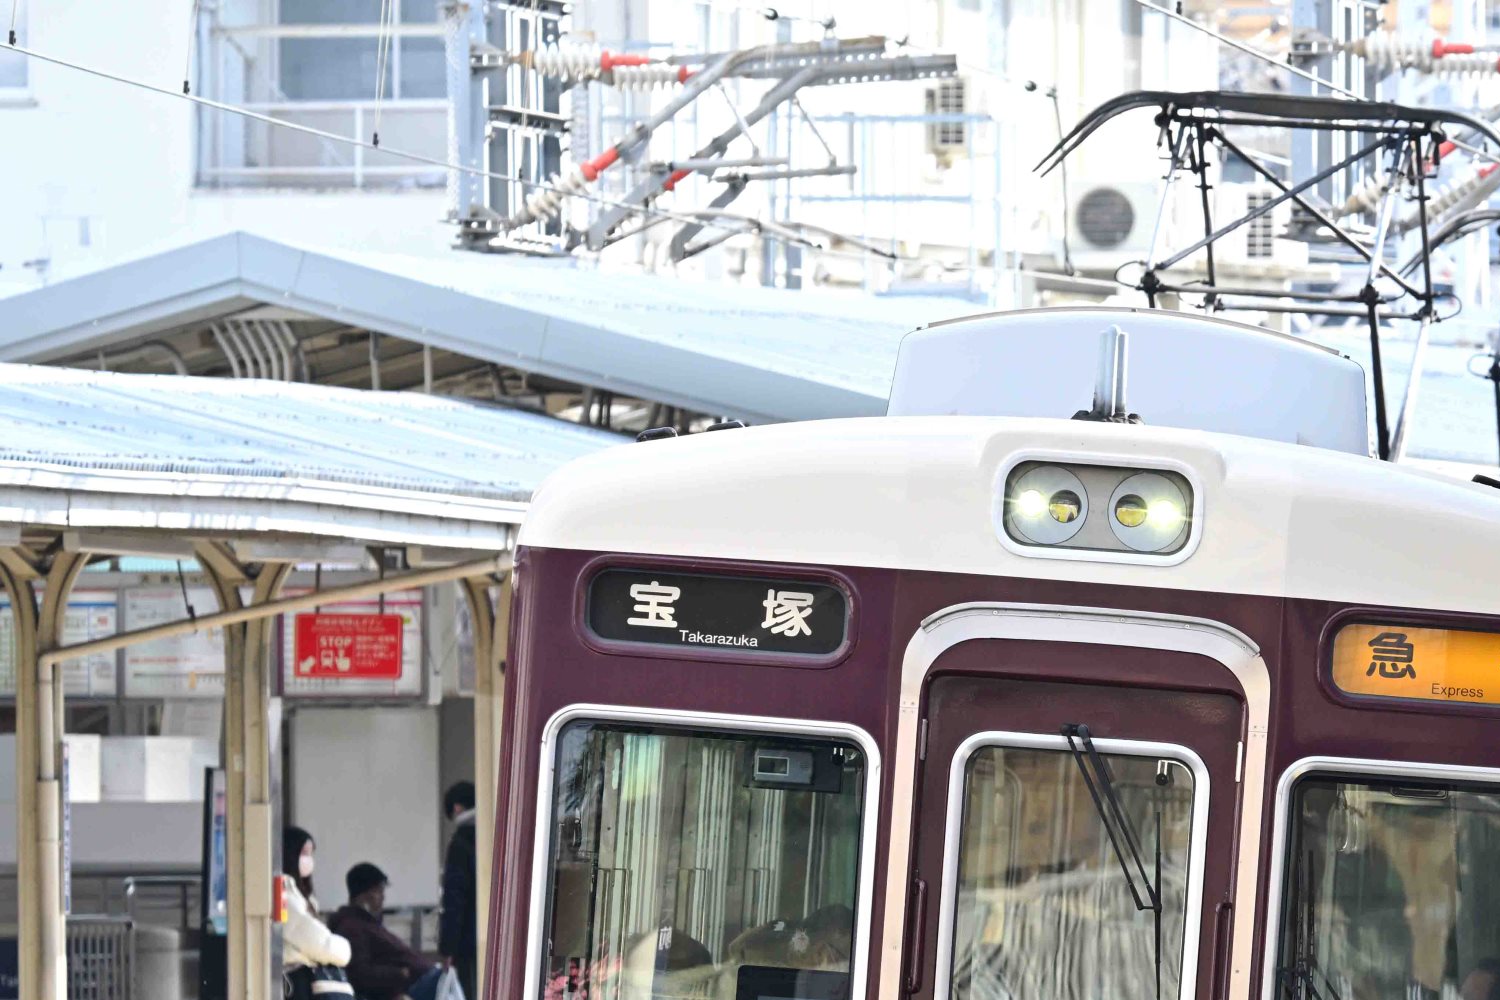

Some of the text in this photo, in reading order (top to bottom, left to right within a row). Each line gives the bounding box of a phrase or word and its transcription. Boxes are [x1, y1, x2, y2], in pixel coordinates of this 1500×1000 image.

[627, 581, 814, 637] 宝塚
[679, 629, 758, 647] Takarazuka
[1432, 683, 1484, 699] Express
